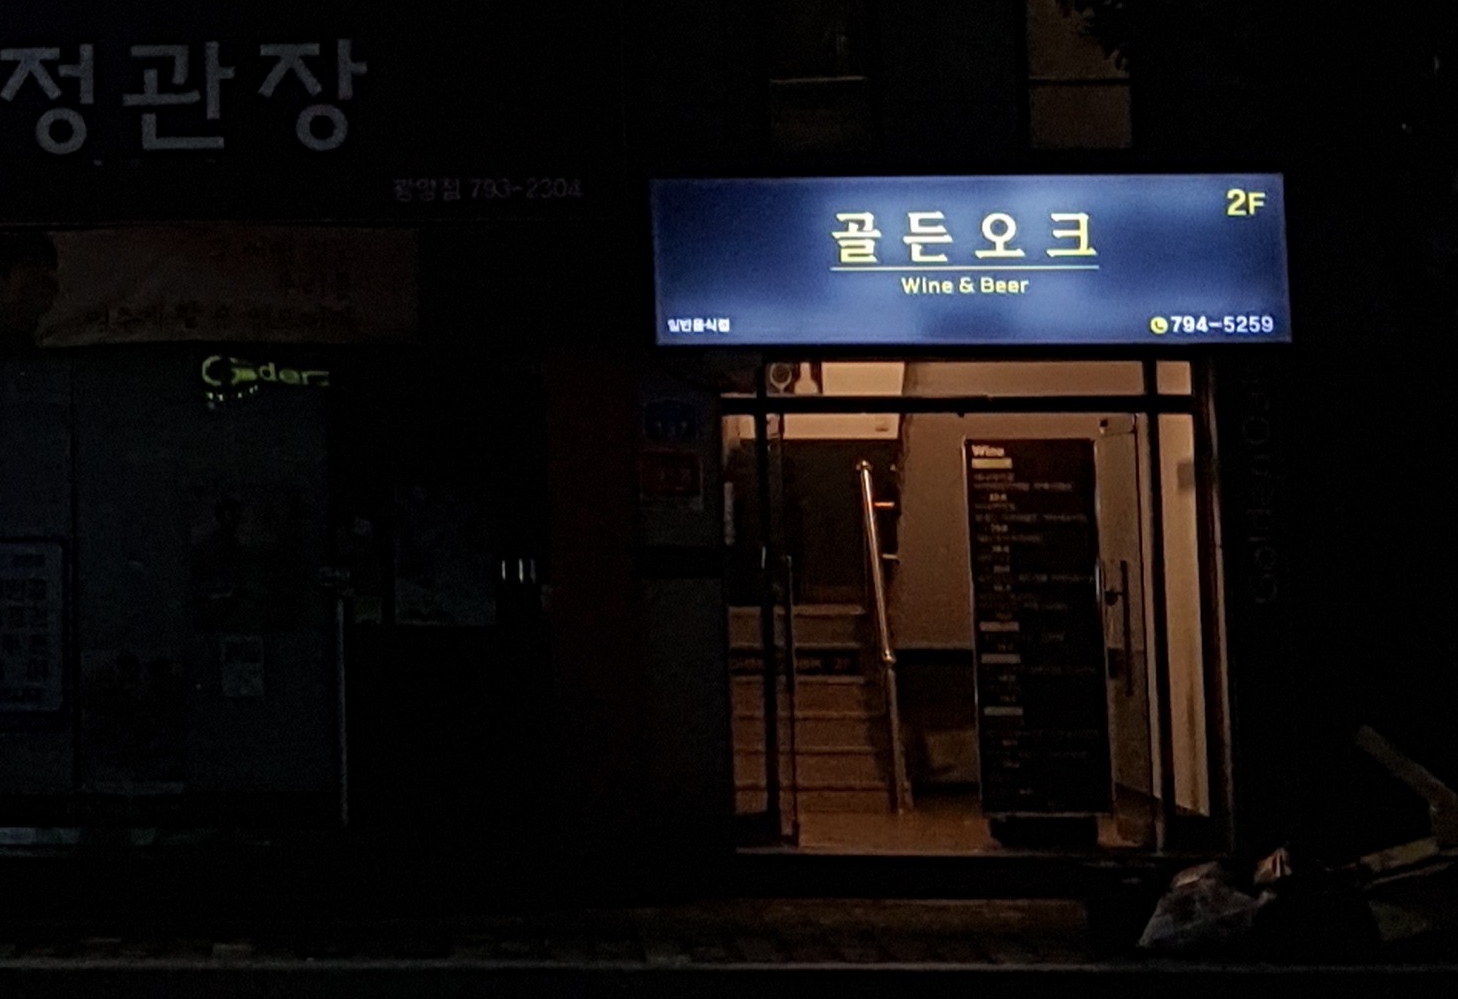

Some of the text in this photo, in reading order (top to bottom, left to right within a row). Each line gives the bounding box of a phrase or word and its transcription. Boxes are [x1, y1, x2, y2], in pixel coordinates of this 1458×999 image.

[0, 38, 368, 155] 정관장
[1227, 188, 1266, 216] 2F
[831, 211, 1099, 263] 골든오크
[900, 276, 1030, 295] Wine & Beer
[1170, 315, 1275, 333] 794-5259
